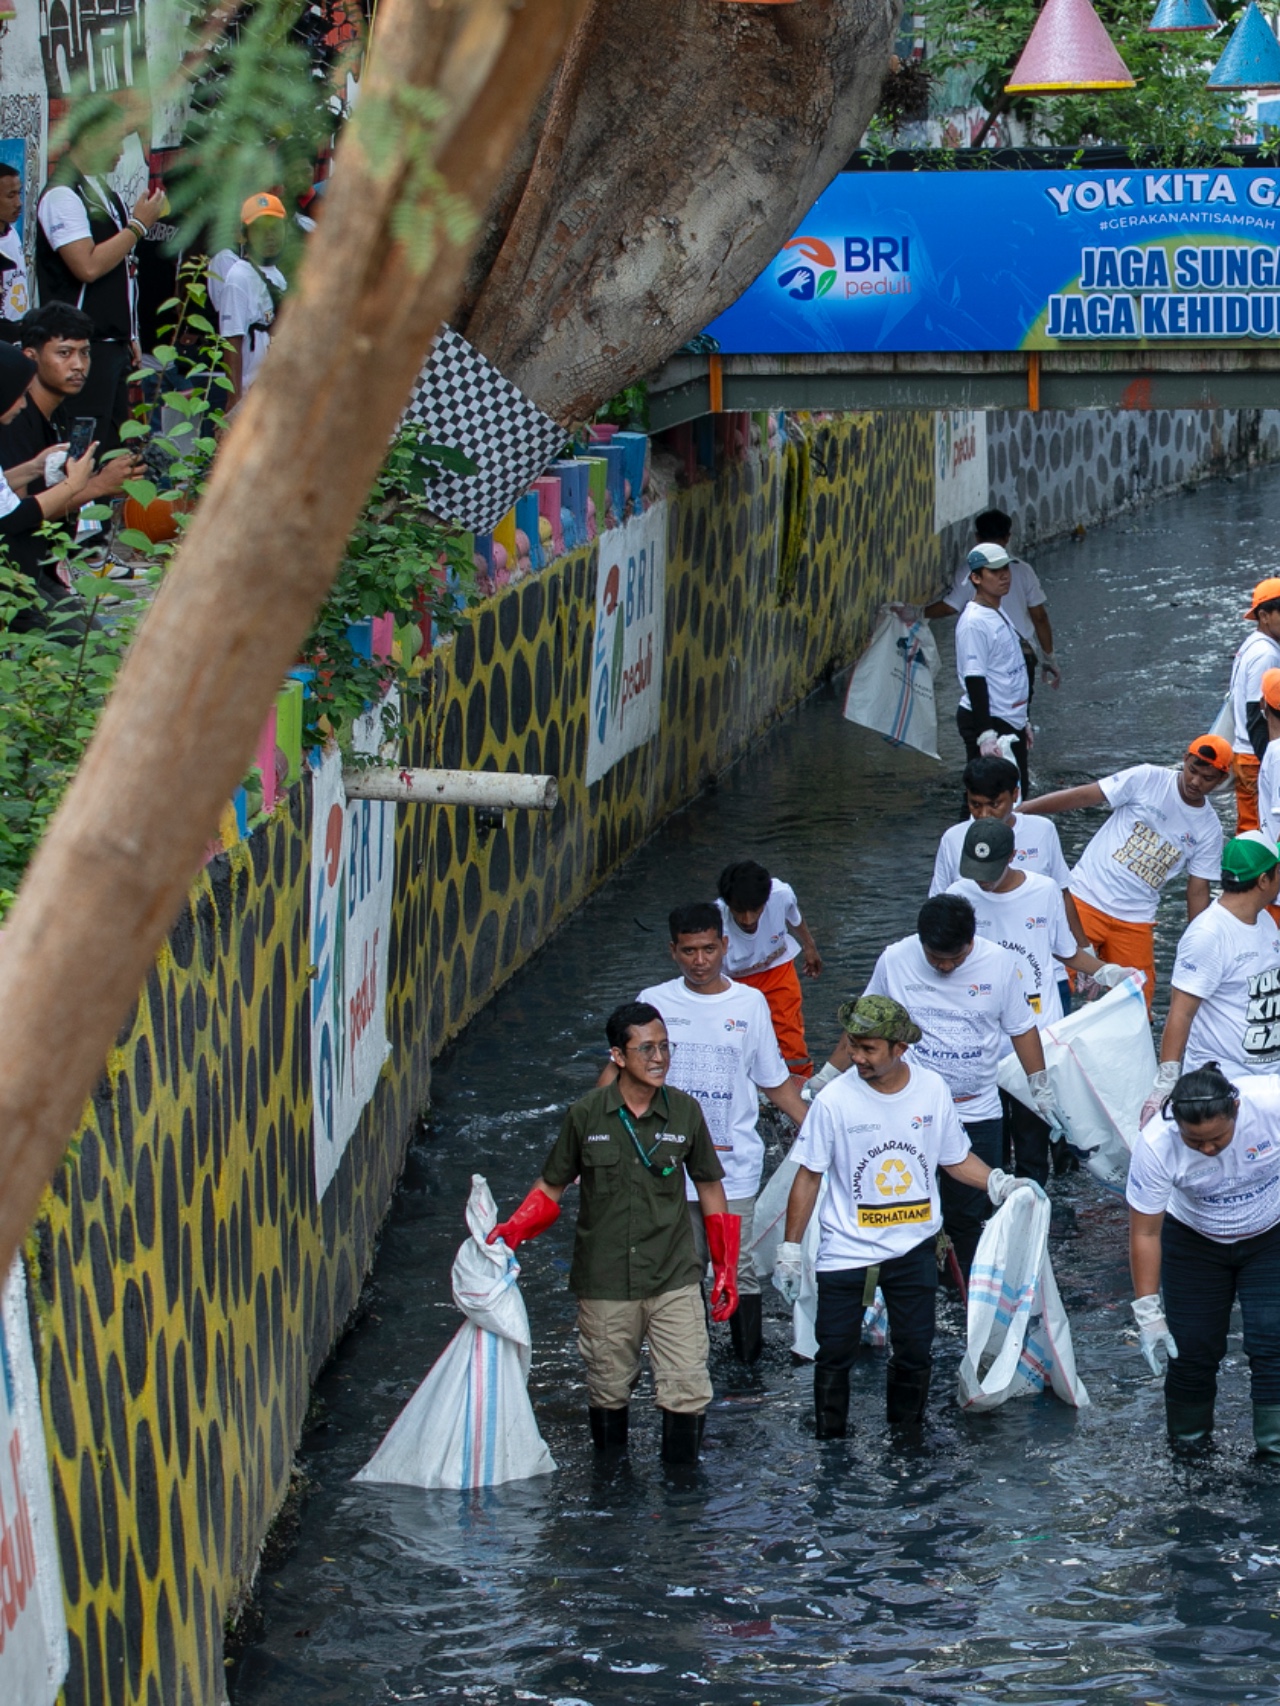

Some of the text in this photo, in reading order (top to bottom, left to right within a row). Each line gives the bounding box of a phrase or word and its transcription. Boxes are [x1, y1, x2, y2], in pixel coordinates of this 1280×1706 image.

[1048, 183, 1135, 214] YOK
[1144, 174, 1238, 205] KITA
[1099, 211, 1276, 231] #GERAKANANTISAMPAH
[844, 236, 910, 273] BRI
[1079, 245, 1173, 291] JAGA
[845, 277, 912, 300] peduli
[1045, 292, 1139, 338] JAGA
[625, 540, 655, 628] BRI
[619, 631, 653, 732] peduli
[349, 927, 380, 1097] peduli
[932, 1050, 960, 1060] KITA
[853, 1157, 870, 1201] SAMPAH
[867, 1140, 918, 1159] DILARANG
[0, 1427, 37, 1656] duli
